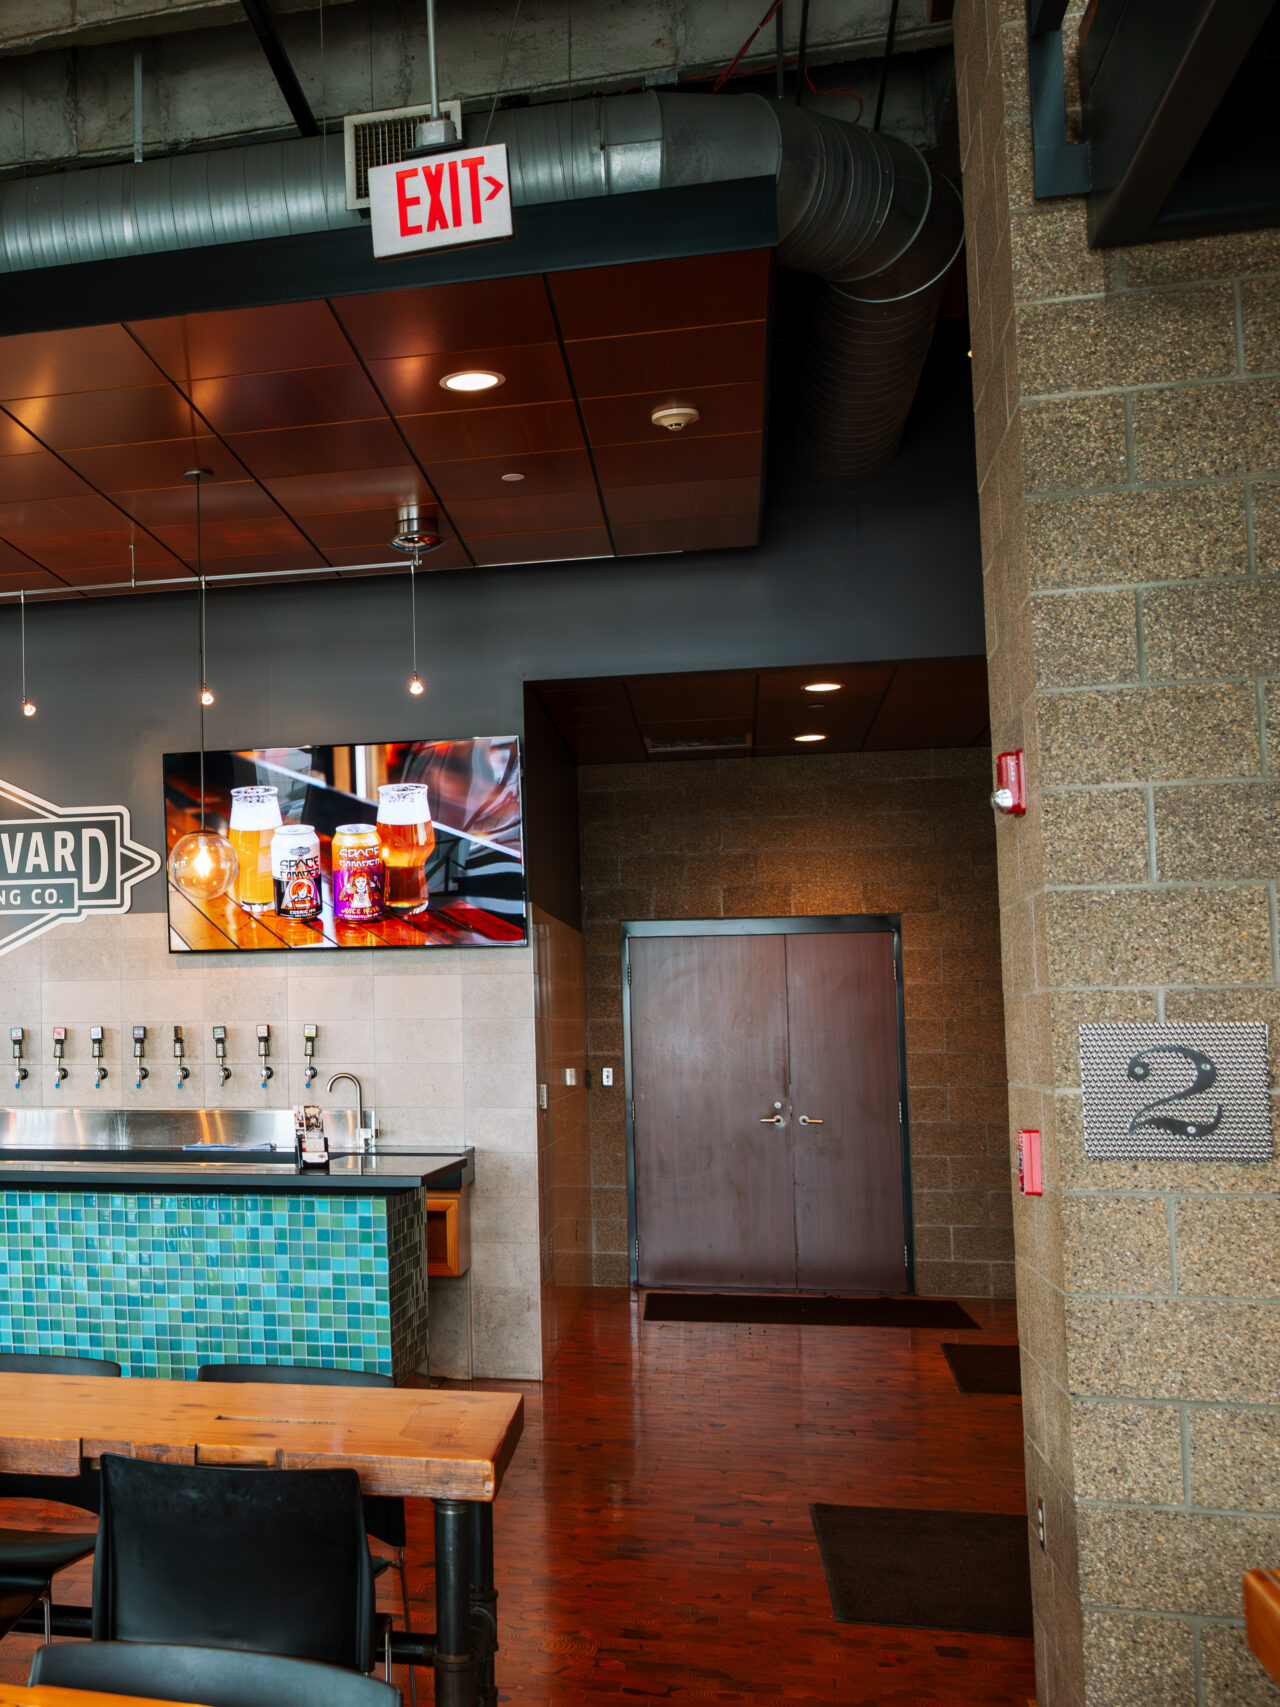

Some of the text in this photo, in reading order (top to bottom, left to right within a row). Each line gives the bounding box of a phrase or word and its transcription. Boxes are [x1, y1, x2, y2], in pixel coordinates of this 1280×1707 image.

[396, 156, 484, 237] EXIT
[31, 887, 64, 905] CO.
[1128, 1045, 1222, 1138] 2
